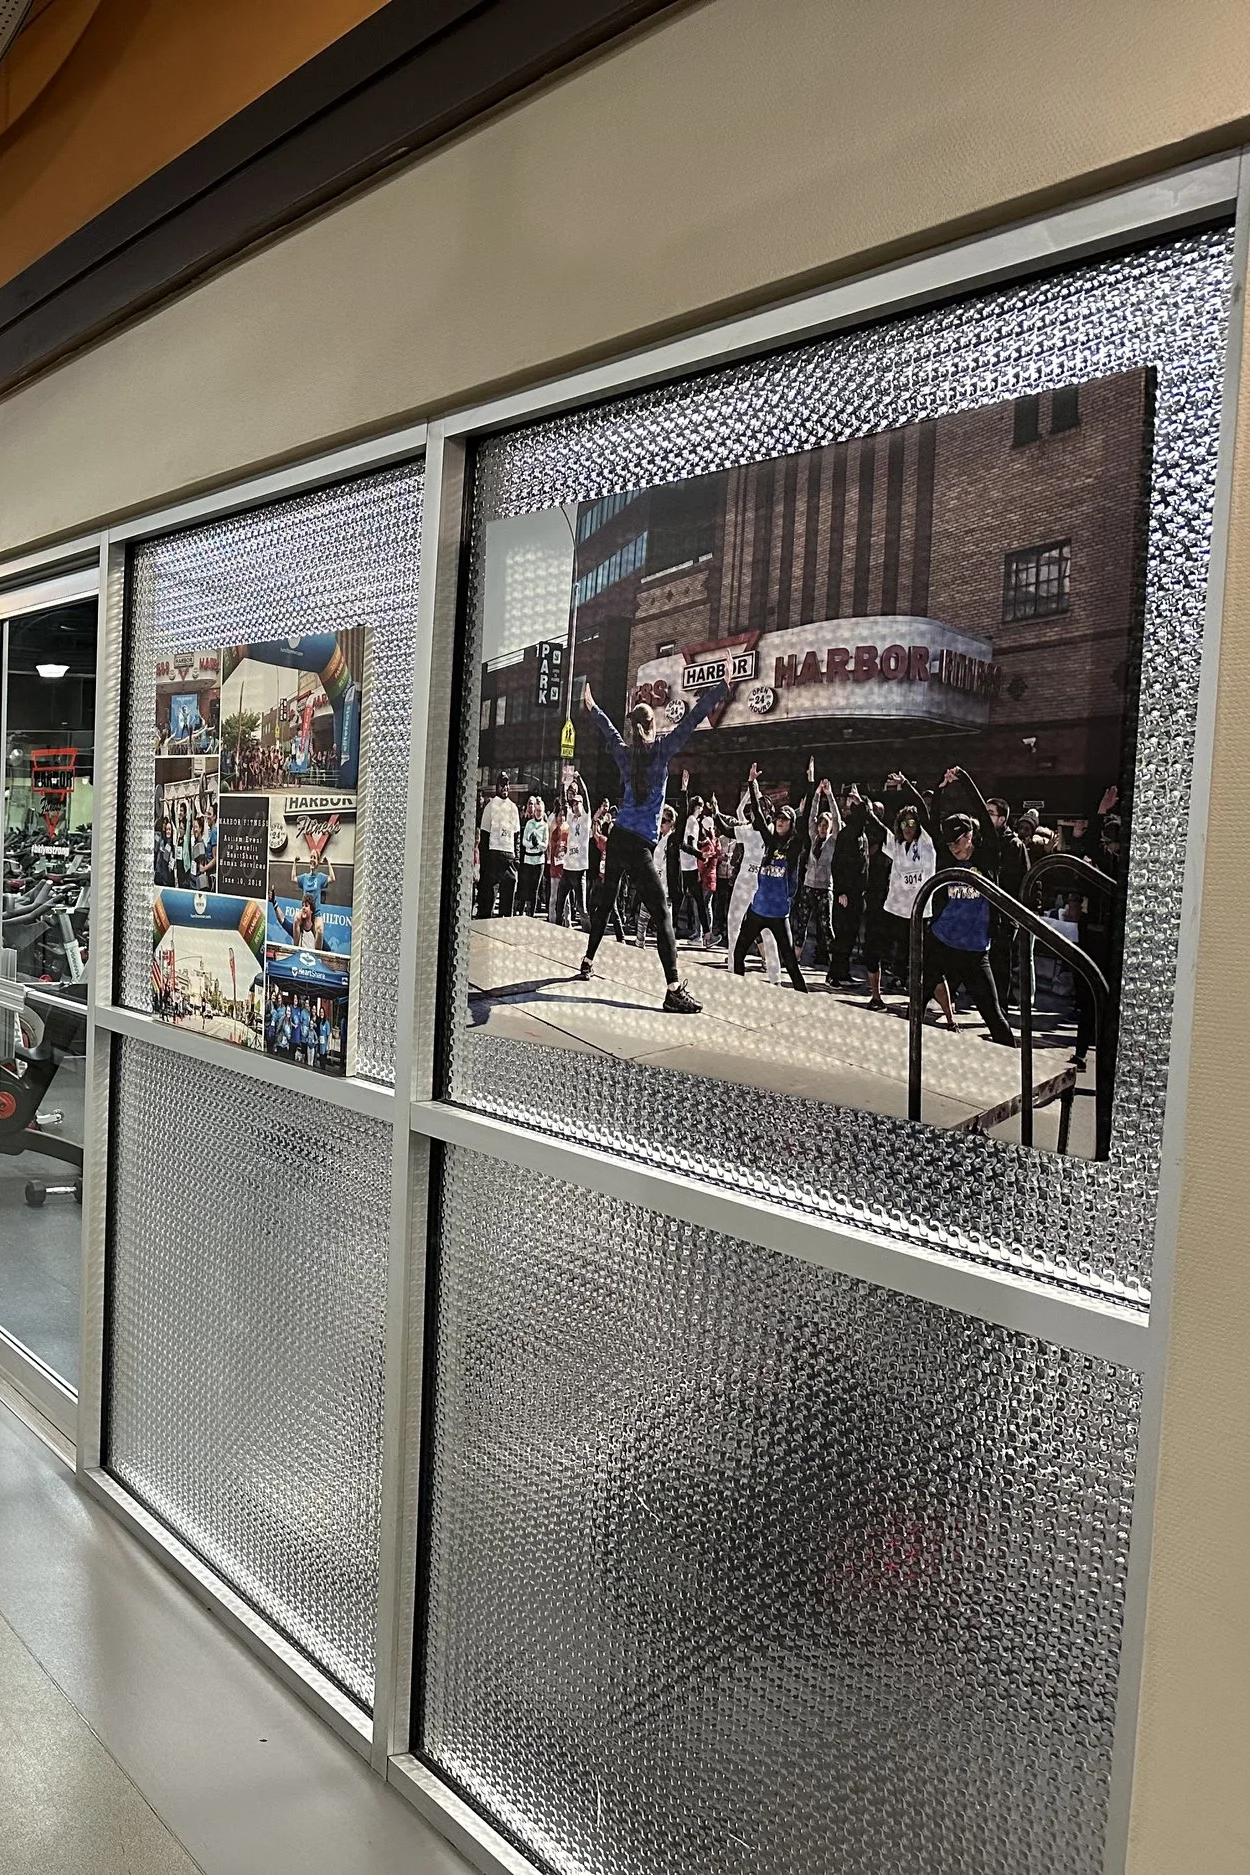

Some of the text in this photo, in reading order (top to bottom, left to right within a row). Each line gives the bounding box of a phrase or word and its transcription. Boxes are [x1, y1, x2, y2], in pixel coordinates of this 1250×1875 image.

[774, 643, 931, 688] HARBOR
[538, 643, 550, 705] PARK
[752, 686, 769, 696] OPEN
[754, 695, 765, 705] 24
[670, 707, 679, 715] 24
[750, 701, 771, 713] HOURS
[219, 818, 269, 827] HARBOR FITNESS
[223, 834, 263, 844] Autism Event
[235, 843, 258, 852] benefit
[239, 860, 266, 870] Services
[904, 873, 923, 885] 3014
